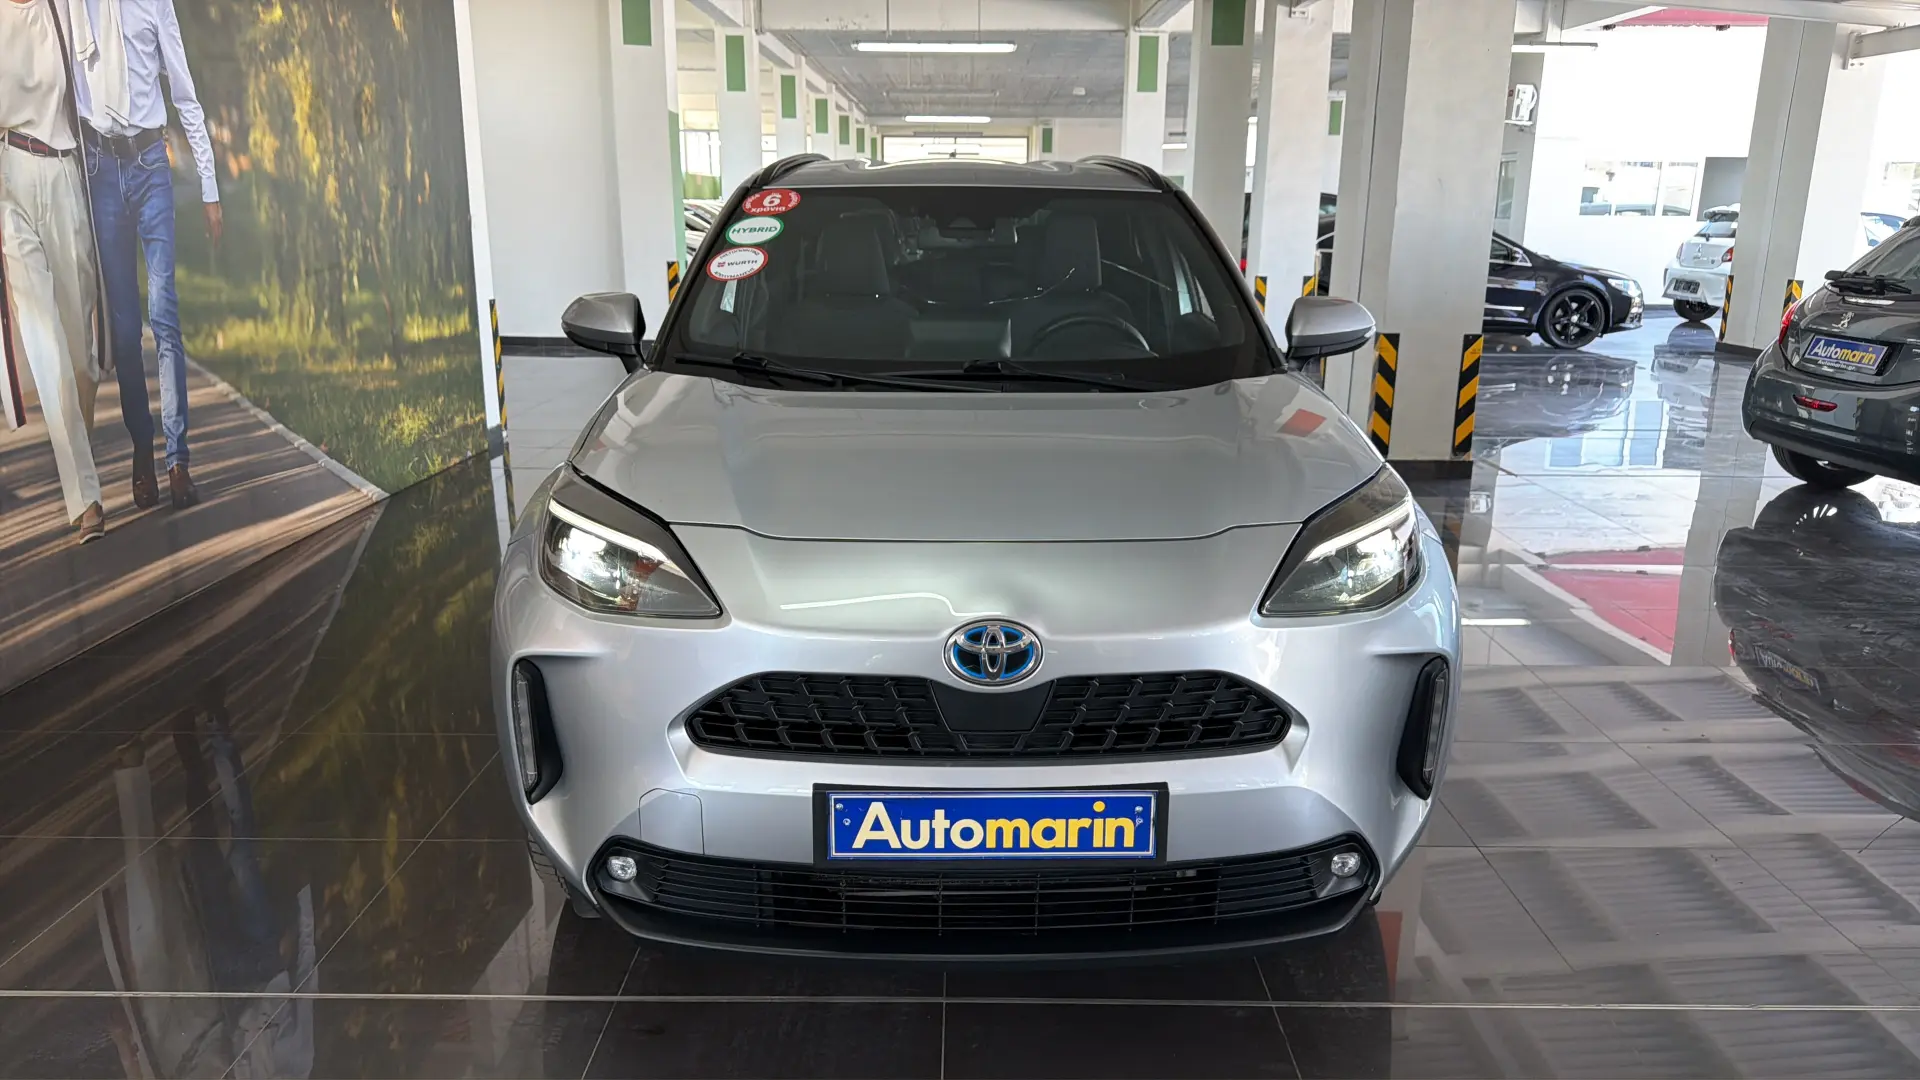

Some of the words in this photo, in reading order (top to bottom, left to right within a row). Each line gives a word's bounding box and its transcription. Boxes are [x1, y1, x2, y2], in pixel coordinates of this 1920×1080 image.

[763, 194, 782, 207] 6
[731, 226, 778, 234] HYBRID
[1810, 339, 1877, 365] Automarin
[851, 800, 1136, 850] Automarin
